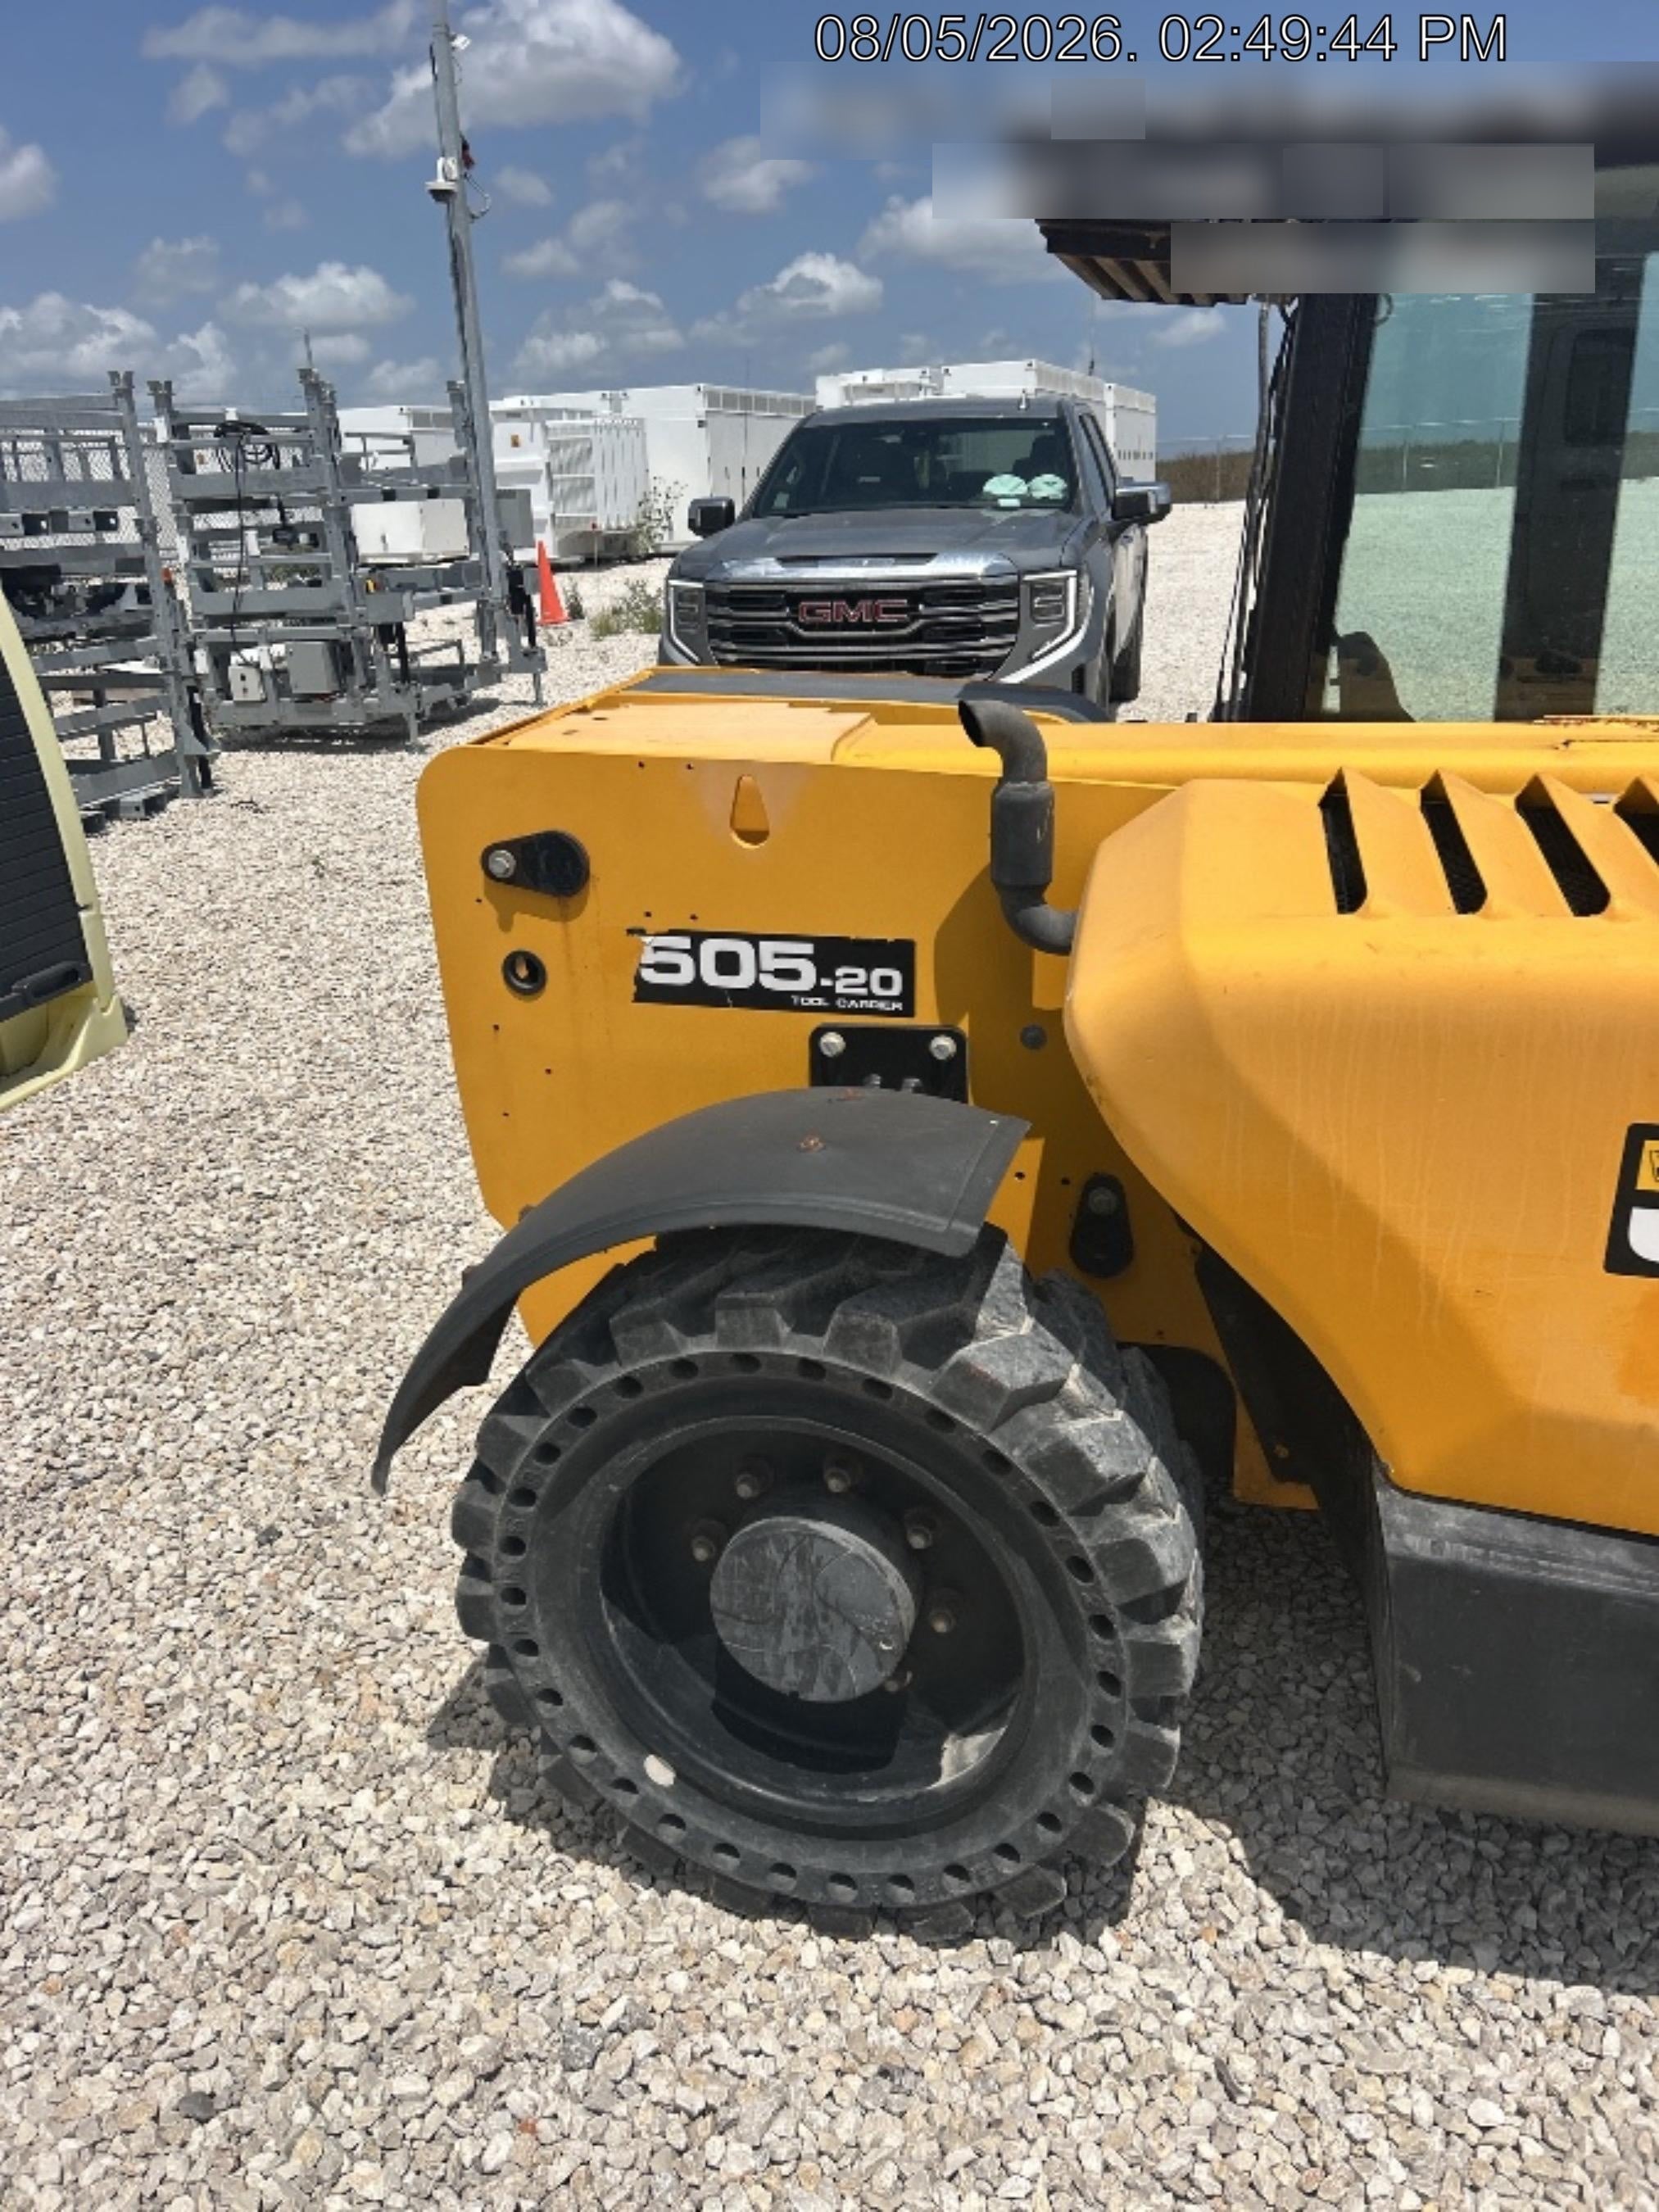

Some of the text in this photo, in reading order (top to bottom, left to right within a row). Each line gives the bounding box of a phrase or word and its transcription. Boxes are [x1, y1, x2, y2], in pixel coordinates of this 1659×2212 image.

[798, 599, 909, 623] GMC
[640, 935, 903, 997] 505-20
[790, 995, 830, 1007] TOOL
